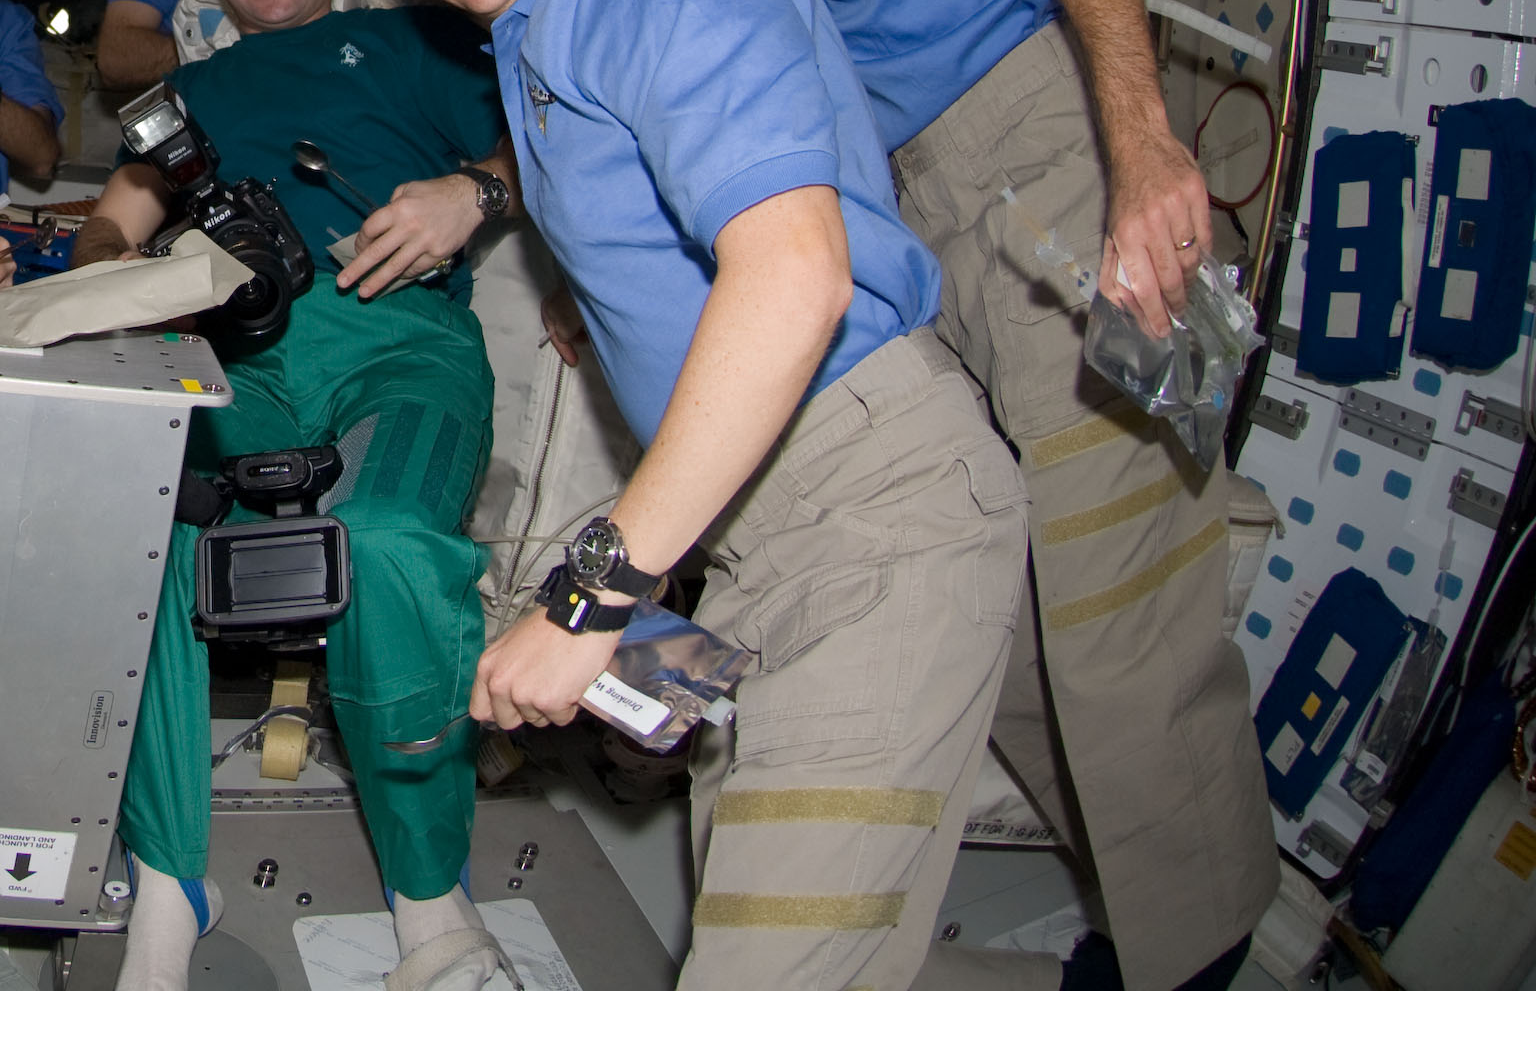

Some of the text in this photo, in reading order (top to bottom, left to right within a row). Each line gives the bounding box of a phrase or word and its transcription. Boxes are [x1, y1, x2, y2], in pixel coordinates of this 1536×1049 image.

[168, 146, 186, 160] Nikon
[204, 209, 231, 230] Nikon
[606, 686, 643, 712] Drinking
[86, 695, 105, 744] Innovision
